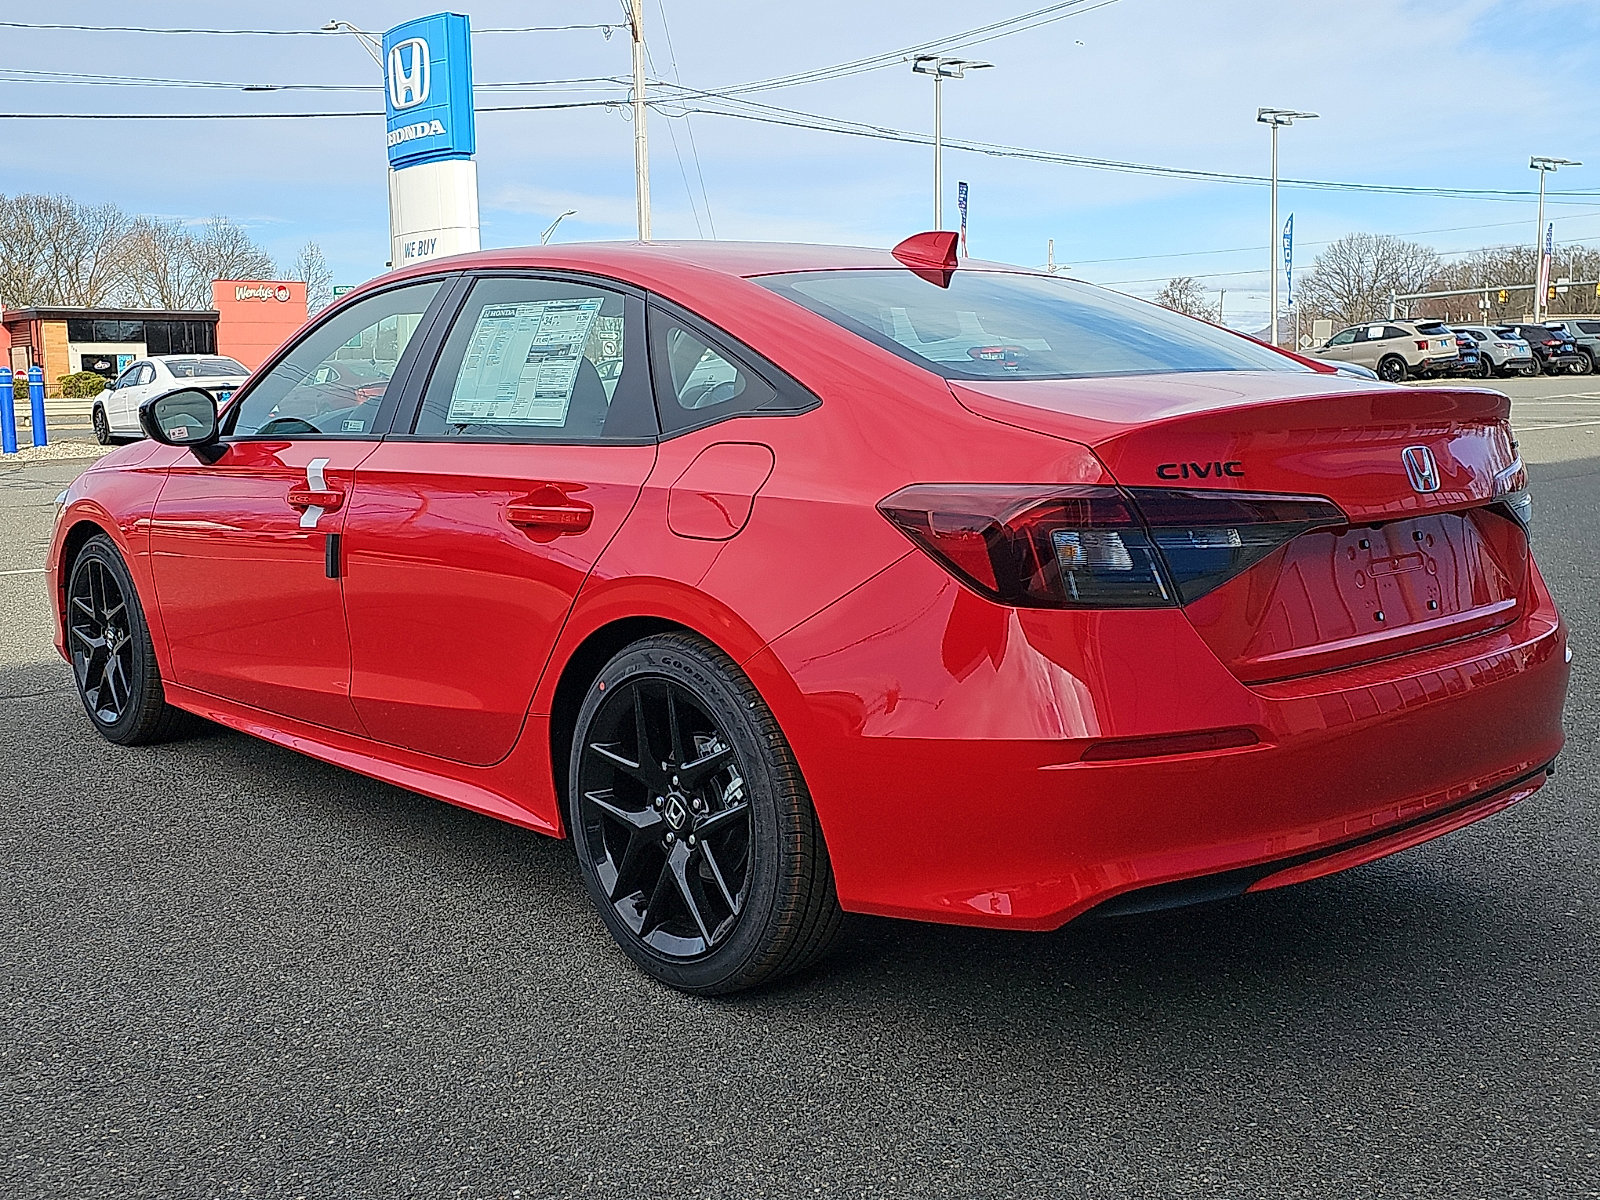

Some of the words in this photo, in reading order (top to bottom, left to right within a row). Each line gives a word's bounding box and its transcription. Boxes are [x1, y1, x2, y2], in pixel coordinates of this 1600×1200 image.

[386, 119, 446, 147] HONDA
[404, 242, 415, 258] WE
[418, 238, 437, 256] BUY
[235, 285, 274, 302] Wendy's
[490, 309, 516, 317] HONDA
[1156, 462, 1245, 479] CIVIC
